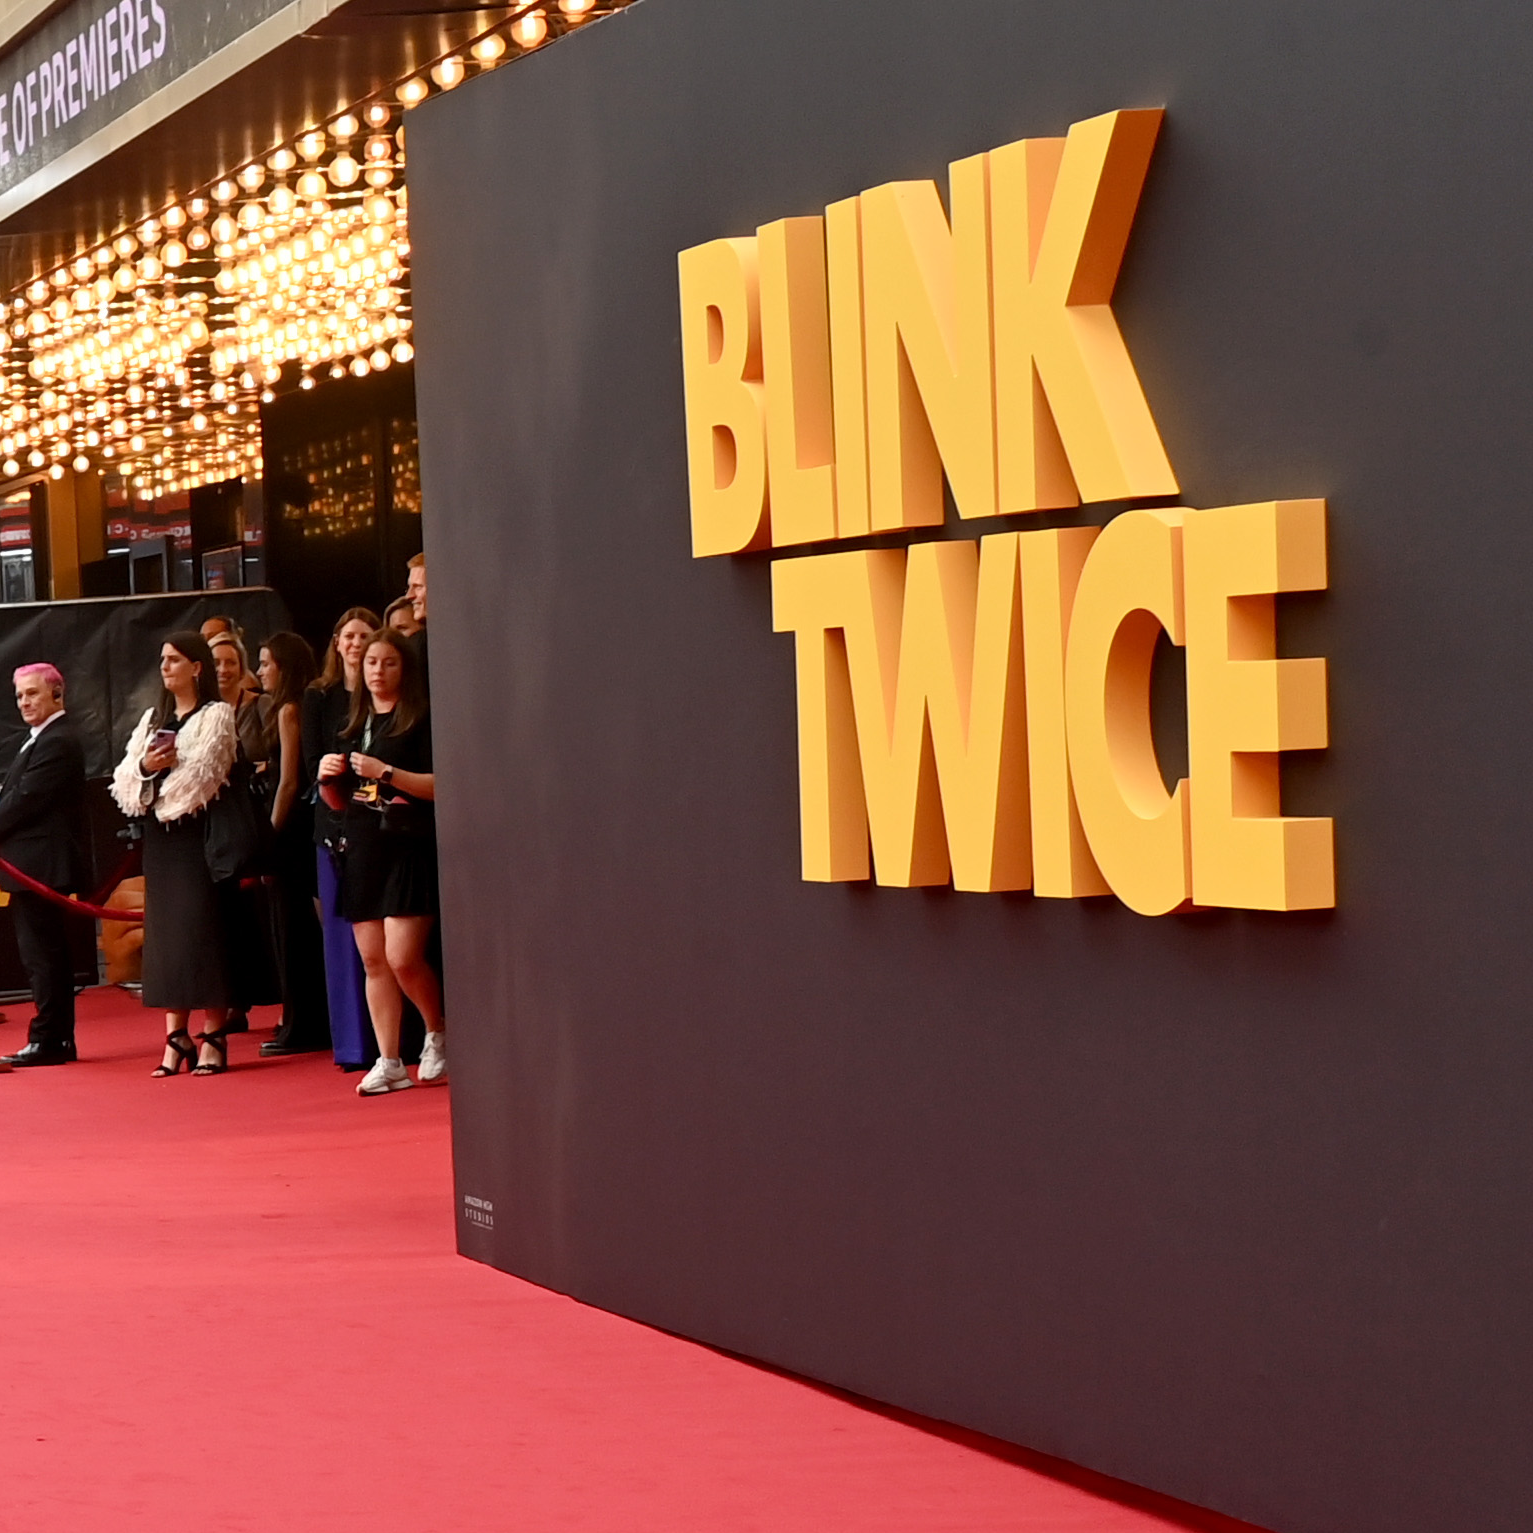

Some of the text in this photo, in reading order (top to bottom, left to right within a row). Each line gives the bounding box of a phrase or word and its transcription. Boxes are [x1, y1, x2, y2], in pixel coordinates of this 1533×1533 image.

[12, 71, 38, 156] OF
[39, 0, 166, 138] PREMIERES
[678, 107, 1179, 558] BLINK
[771, 498, 1335, 917] TWICE
